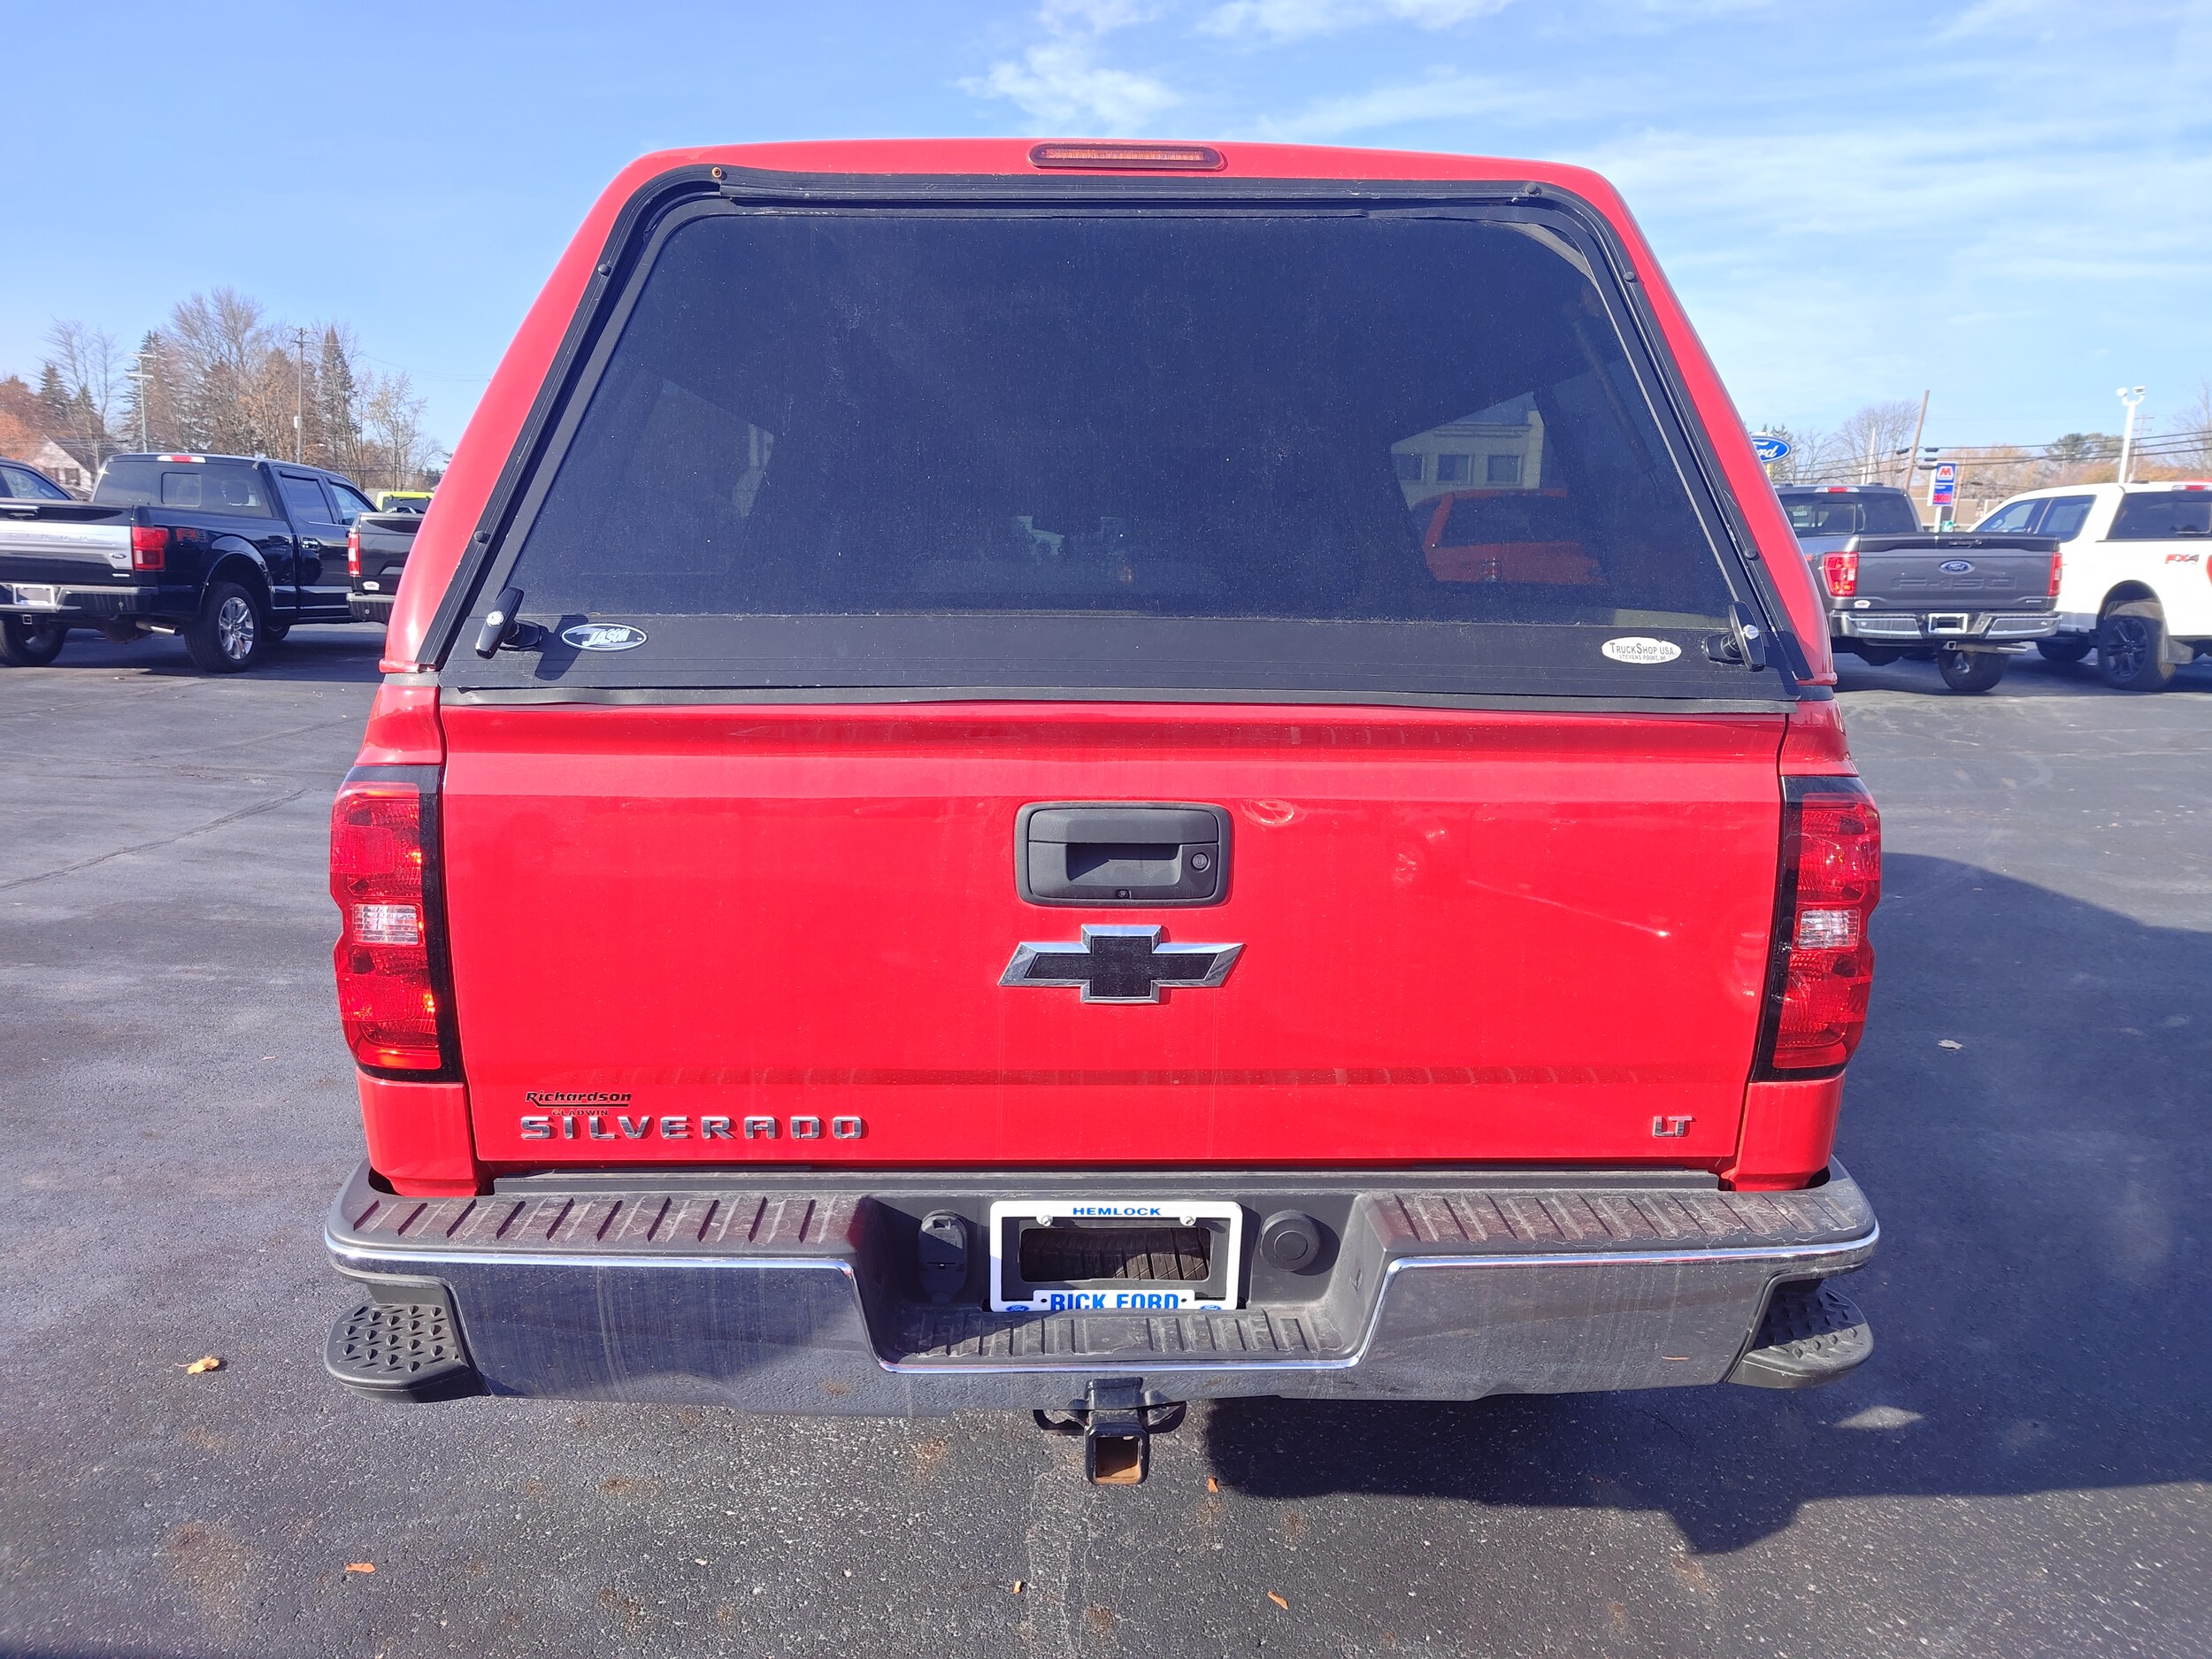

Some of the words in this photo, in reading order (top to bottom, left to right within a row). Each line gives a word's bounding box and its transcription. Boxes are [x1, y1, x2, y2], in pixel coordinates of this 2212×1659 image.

[581, 628, 631, 647] JASON
[1660, 647, 1675, 656] USA
[526, 1090, 633, 1102] Richardson
[520, 1116, 863, 1141] SILVERADO
[1652, 1116, 1693, 1138] LT
[1072, 1207, 1162, 1216] HEMLOCK
